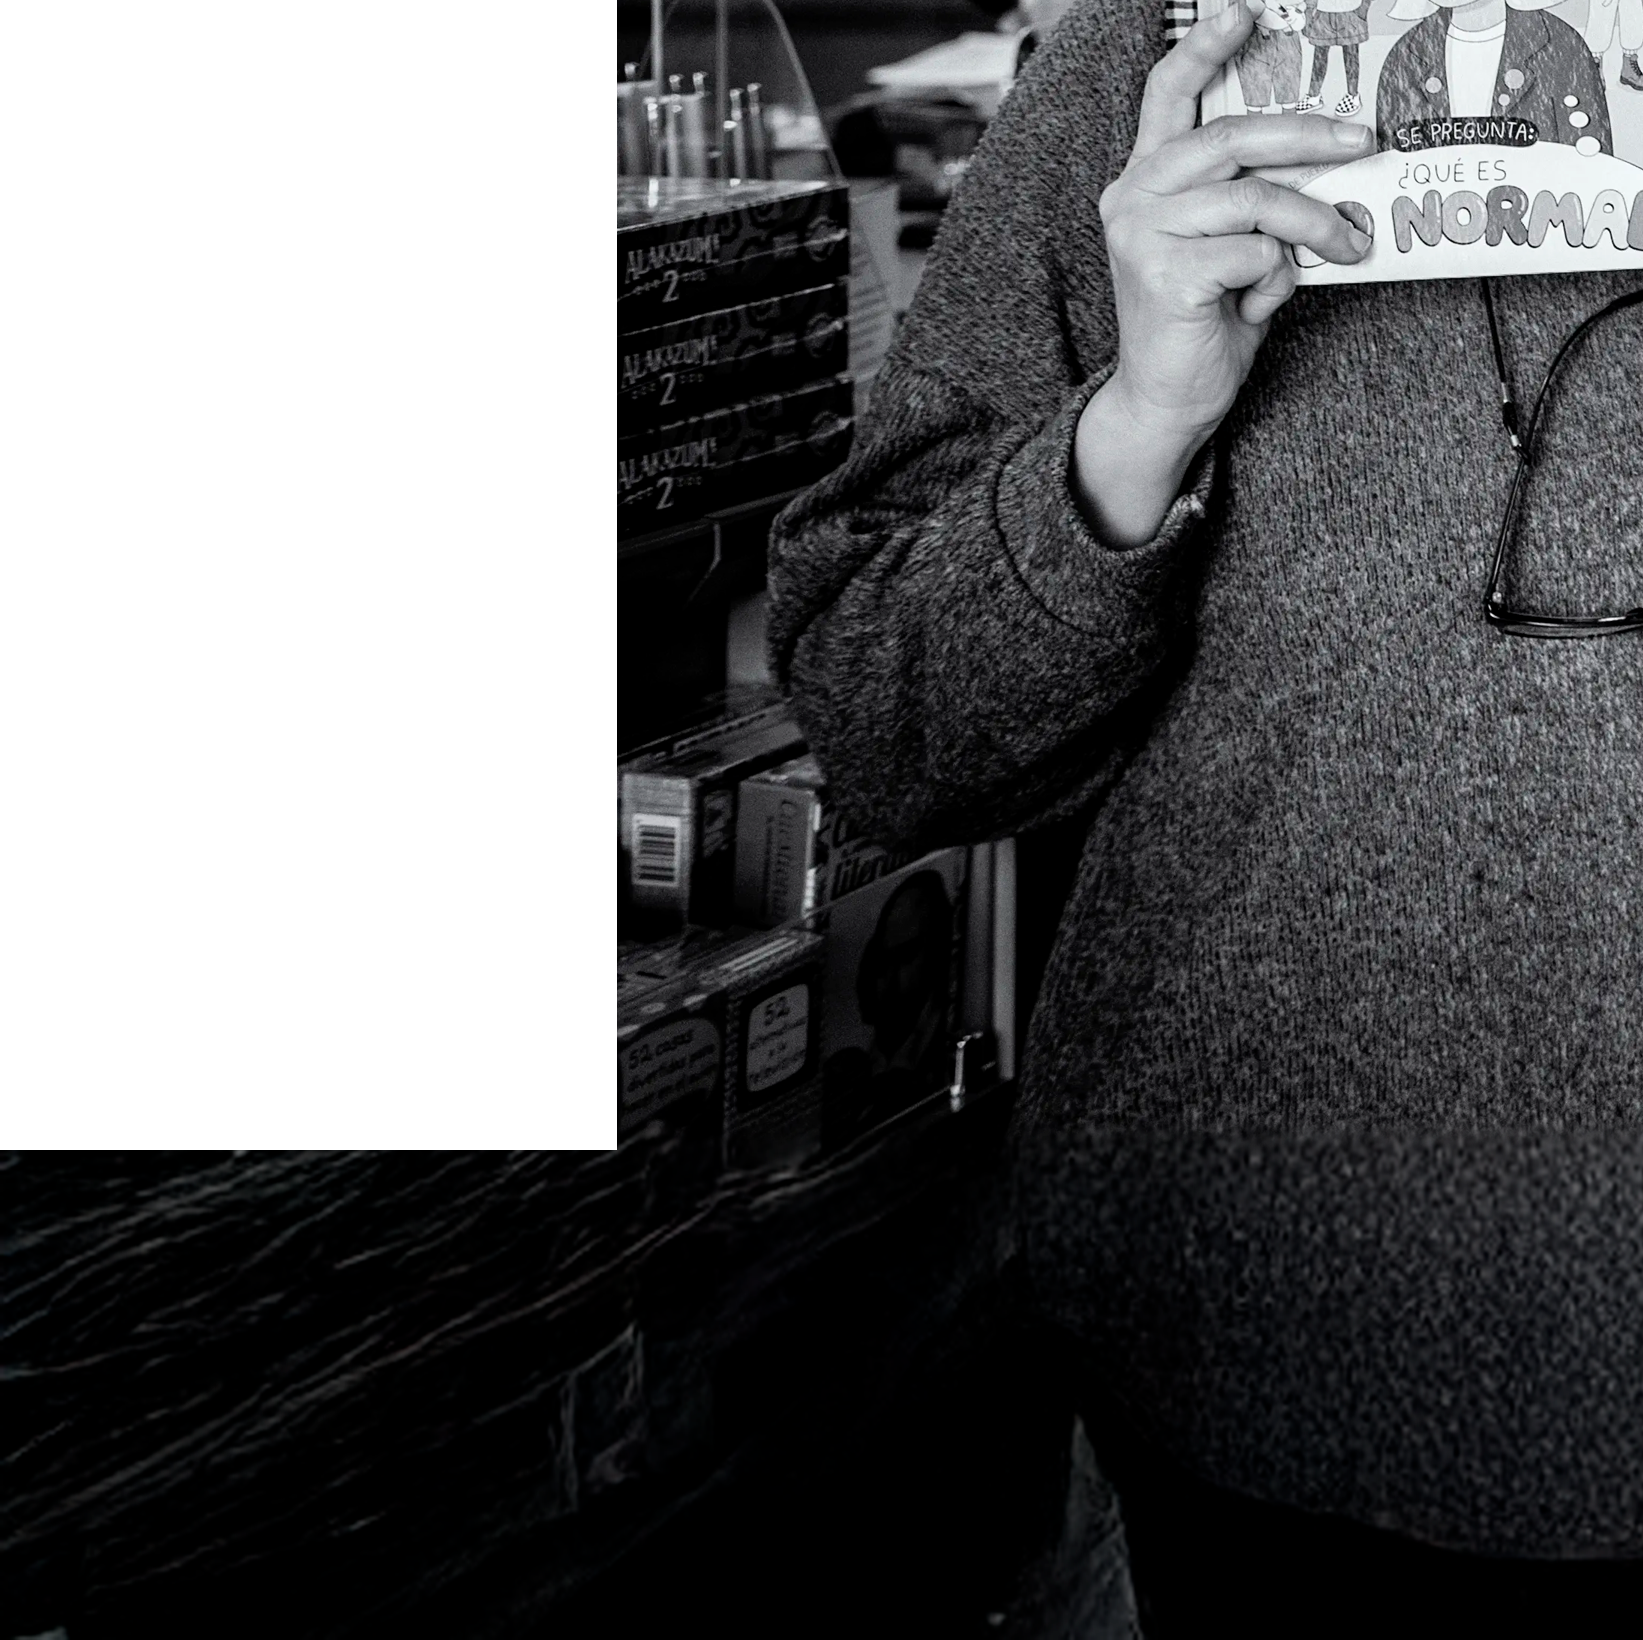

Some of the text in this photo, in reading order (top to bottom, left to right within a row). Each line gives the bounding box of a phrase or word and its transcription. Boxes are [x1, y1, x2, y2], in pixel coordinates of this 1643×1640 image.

[1396, 120, 1535, 148] SE PREGUNTA:
[1287, 177, 1300, 190] DE
[1398, 158, 1507, 190] ¿QUÉ ES
[661, 269, 680, 303] 2
[659, 372, 677, 406] 2
[656, 476, 674, 510] 2
